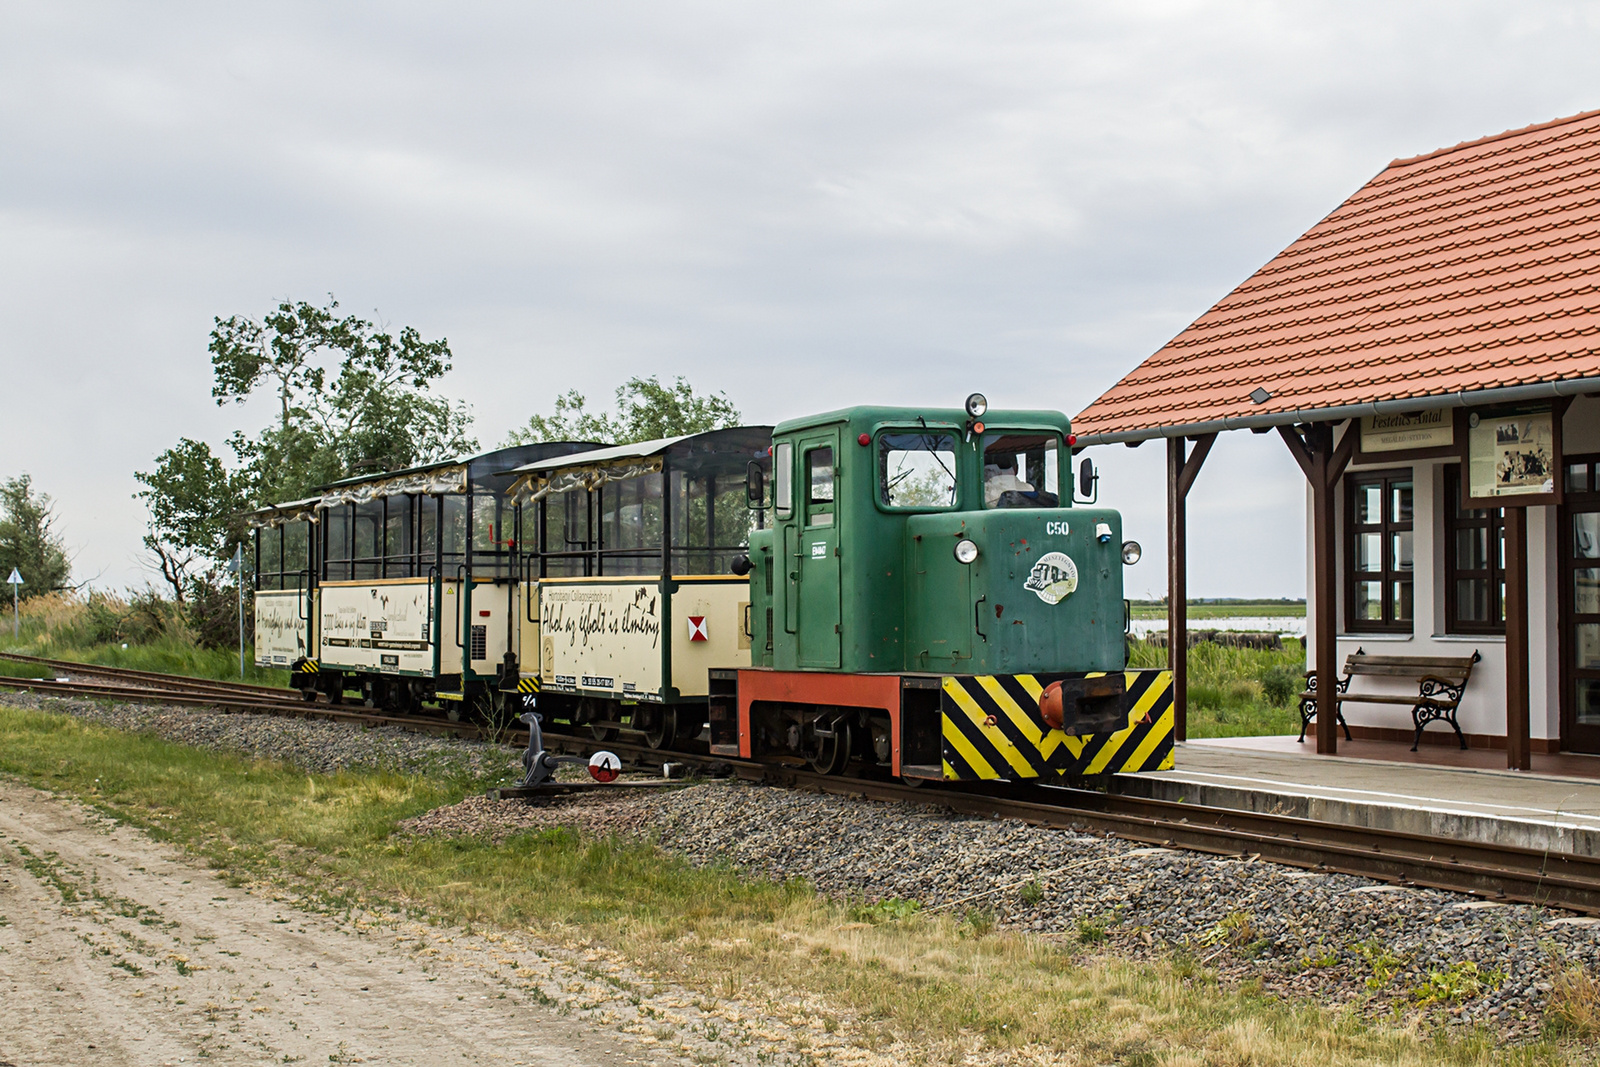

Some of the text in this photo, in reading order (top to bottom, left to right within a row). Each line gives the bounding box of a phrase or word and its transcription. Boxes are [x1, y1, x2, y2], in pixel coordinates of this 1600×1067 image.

[1046, 521, 1069, 536] C50
[542, 602, 660, 649] Ahol az égbolt is élmény
[597, 757, 613, 778] A
